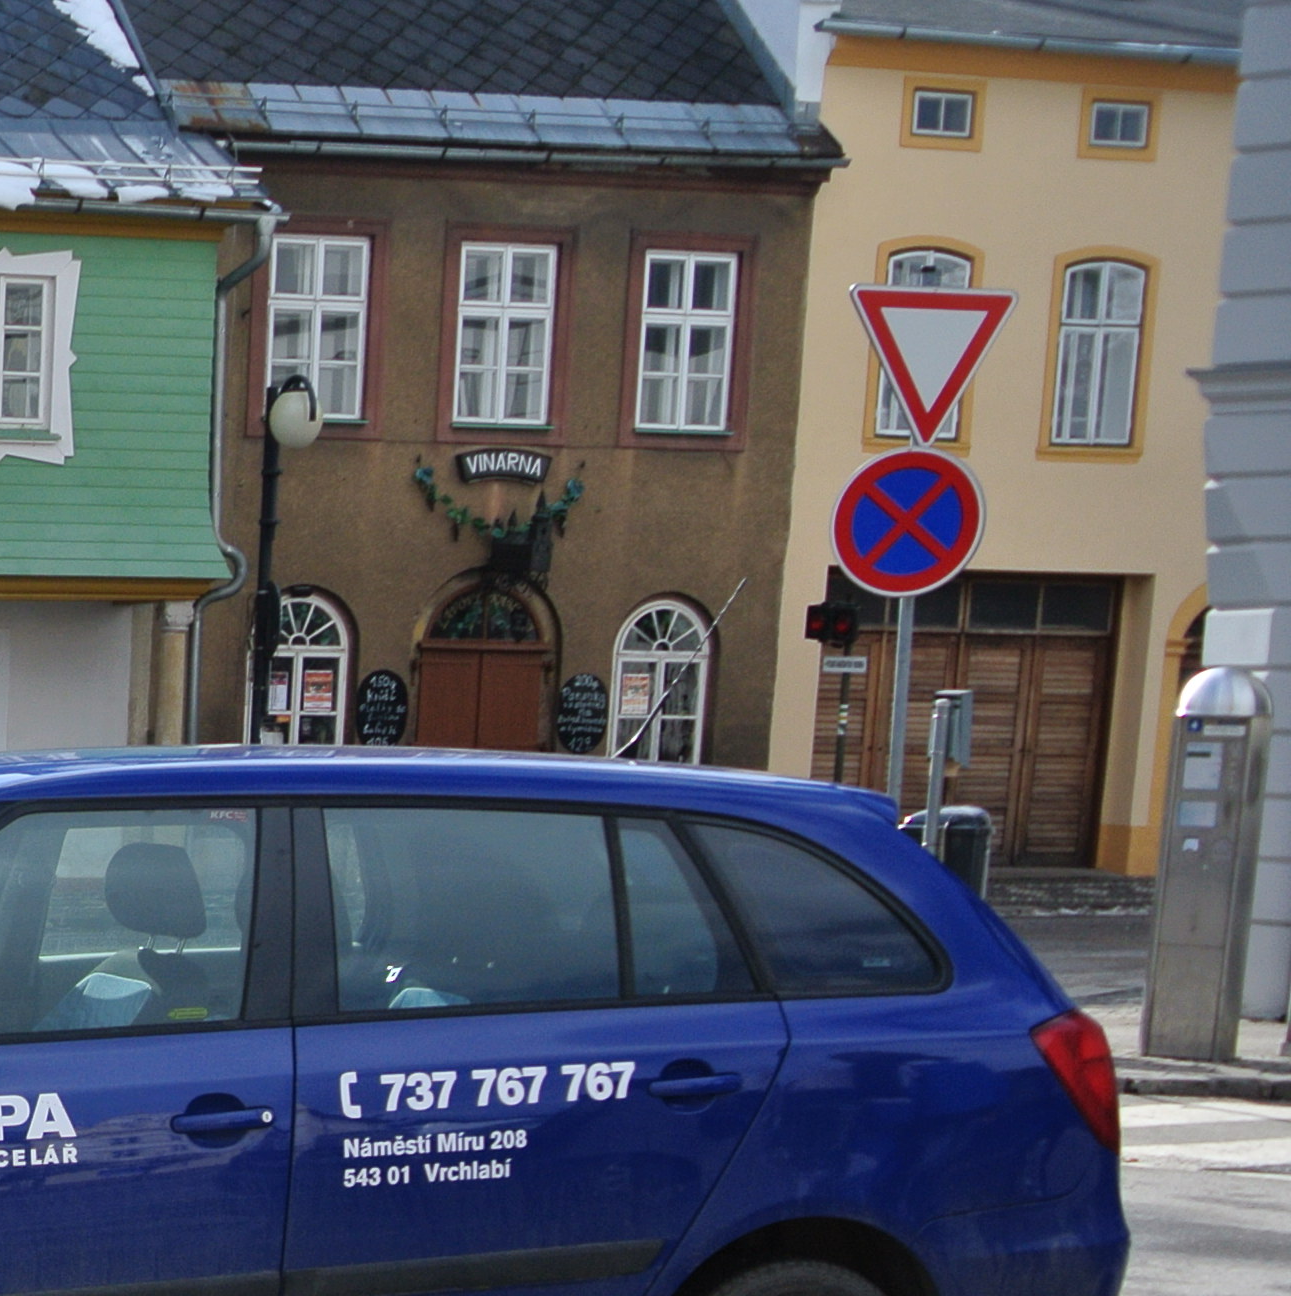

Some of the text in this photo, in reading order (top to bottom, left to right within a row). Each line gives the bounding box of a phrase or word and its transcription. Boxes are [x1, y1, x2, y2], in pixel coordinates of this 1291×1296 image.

[467, 451, 542, 477] VINÁRNA
[380, 1061, 635, 1112] 737 767 767
[343, 1129, 527, 1159] Náměstí Míru 208
[343, 1158, 513, 1188] 543 01 Vrchlabí
